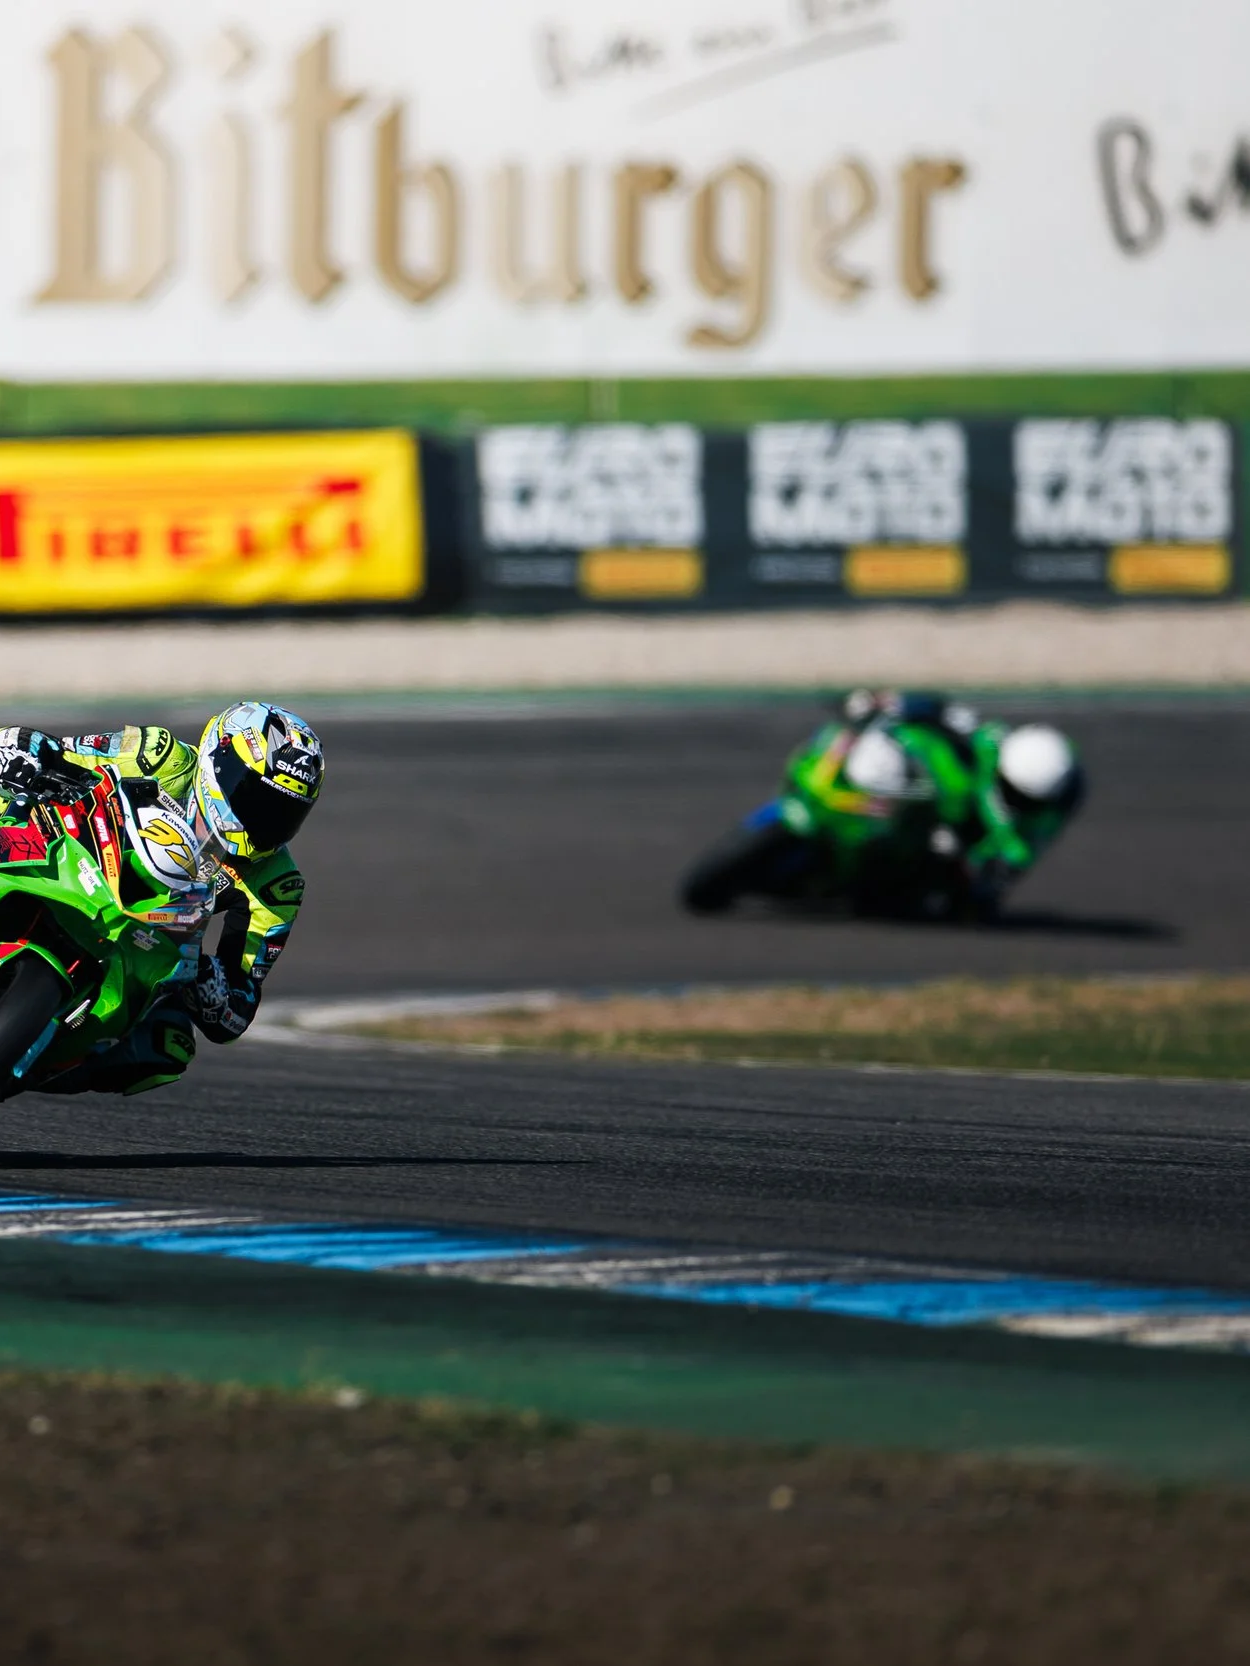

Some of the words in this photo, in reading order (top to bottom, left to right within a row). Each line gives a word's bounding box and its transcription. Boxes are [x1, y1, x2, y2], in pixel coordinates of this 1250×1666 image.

[30, 26, 966, 348] Bitburger
[275, 760, 316, 784] SHARK
[161, 794, 185, 819] SHARK
[94, 816, 110, 842] MOTUL
[161, 812, 199, 851] Kawasaki
